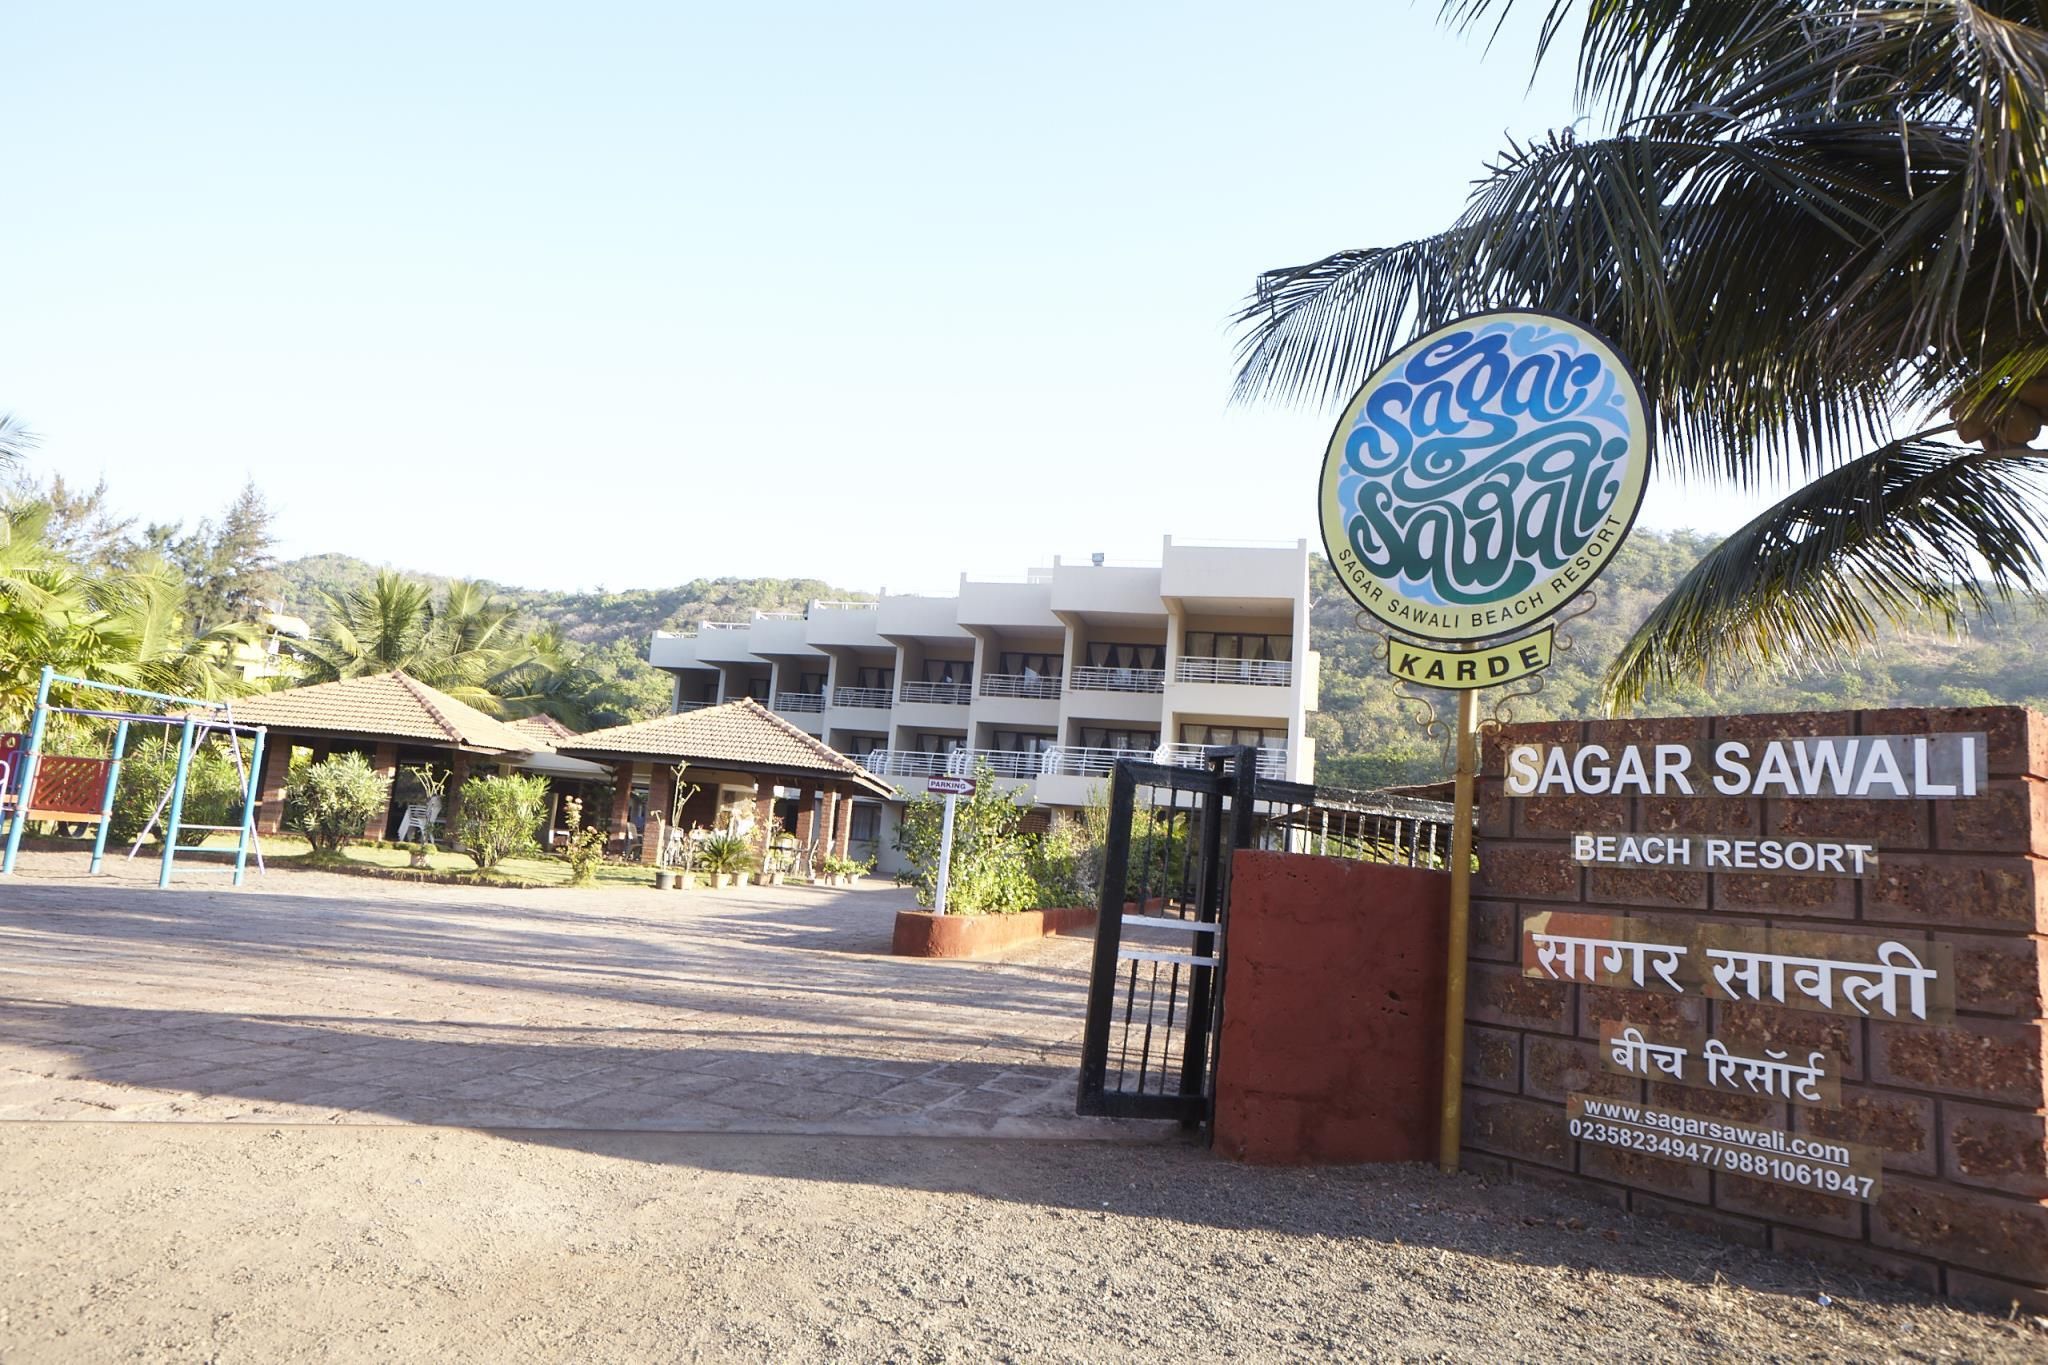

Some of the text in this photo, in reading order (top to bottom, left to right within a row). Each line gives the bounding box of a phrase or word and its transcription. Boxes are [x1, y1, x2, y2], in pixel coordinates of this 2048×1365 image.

[1345, 331, 1601, 478] Sagar
[1348, 420, 1628, 605] Sawali
[1338, 515, 1621, 629] SAGAR SAWALI BEACH RESORT
[1399, 644, 1544, 681] KARDE
[931, 781, 966, 789] PARKING
[1509, 737, 1977, 797] SAGAR SAWALI
[1575, 835, 1873, 875] BEACH RESORT
[1532, 934, 1937, 1020] सागर सावली
[1611, 1028, 1825, 1101] बीच रिसॉर्ट
[1569, 1118, 1875, 1200] 02358234947/9881061947
[1584, 1100, 1849, 1166] www.sagarsawali.com
